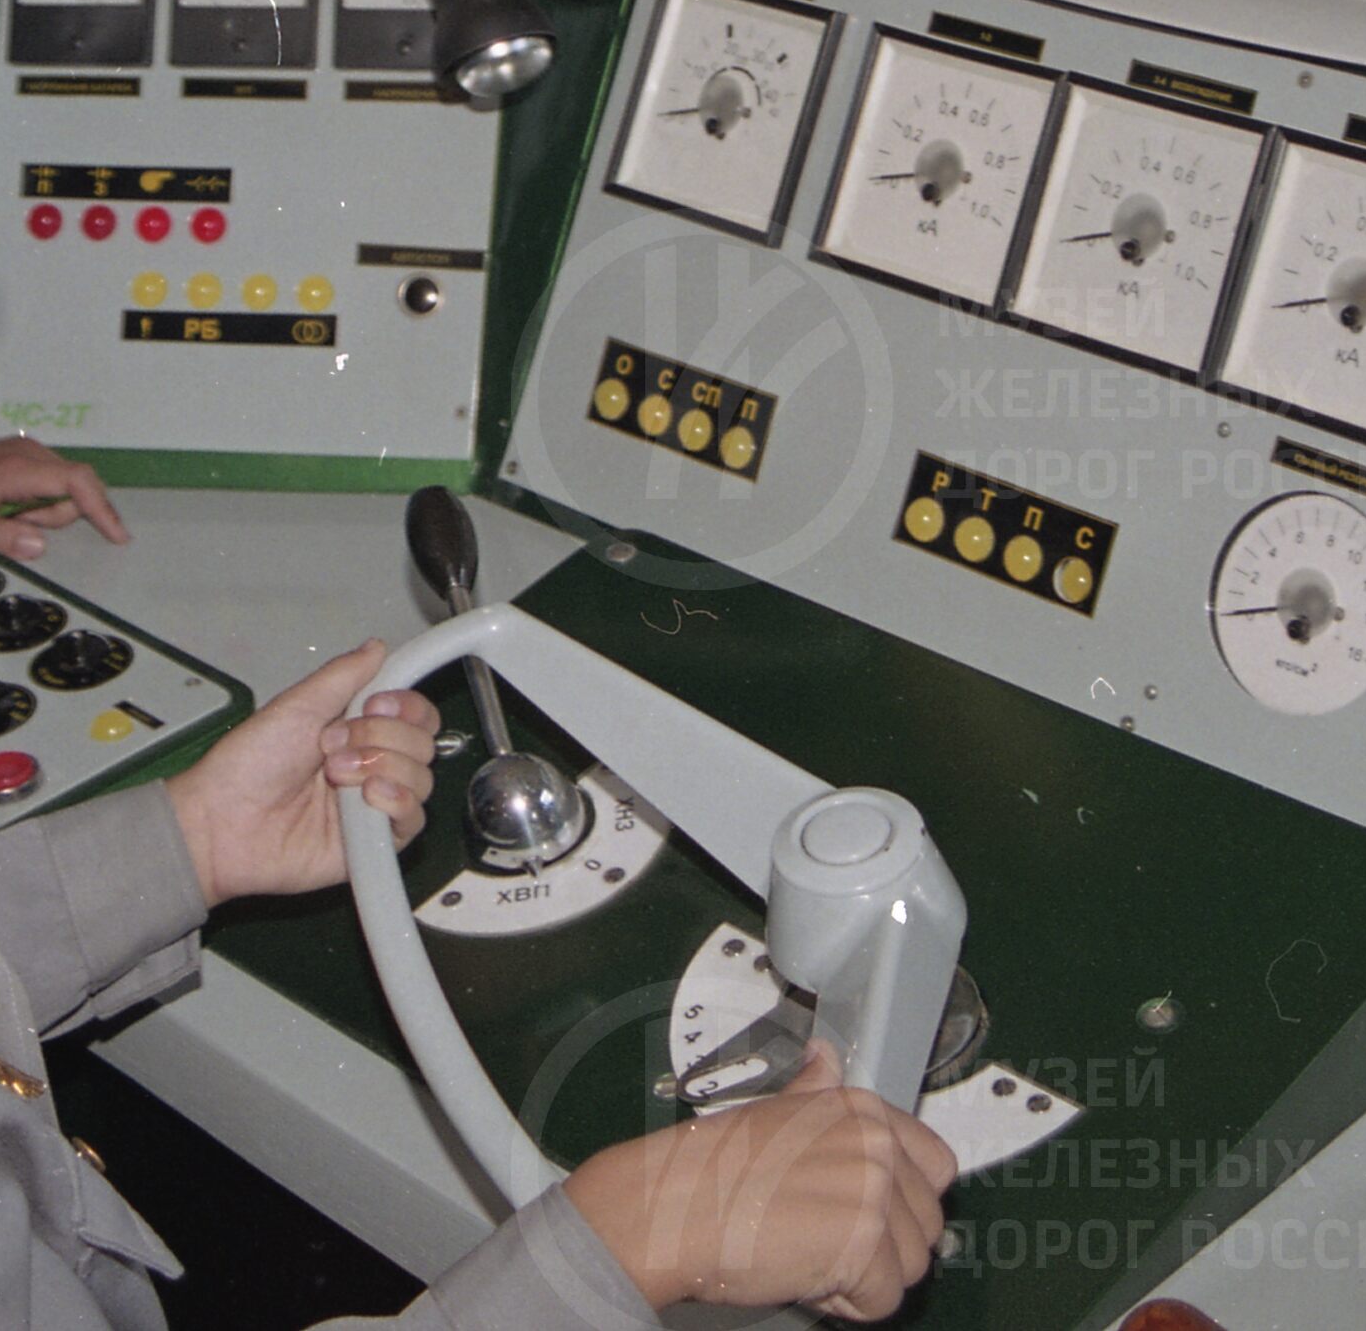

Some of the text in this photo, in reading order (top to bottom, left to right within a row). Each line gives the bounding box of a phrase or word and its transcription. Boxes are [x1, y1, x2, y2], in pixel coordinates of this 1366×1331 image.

[184, 318, 221, 340] РБ
[658, 369, 675, 390] С
[691, 381, 722, 408] СП
[741, 398, 759, 421] П
[932, 470, 952, 492] Р
[980, 488, 997, 512] Т
[1023, 505, 1044, 531] П
[1075, 527, 1095, 550] С
[496, 883, 551, 905] ХВП
[684, 1004, 705, 1020] 5
[683, 1029, 703, 1044] 4
[697, 1079, 719, 1100] 2
